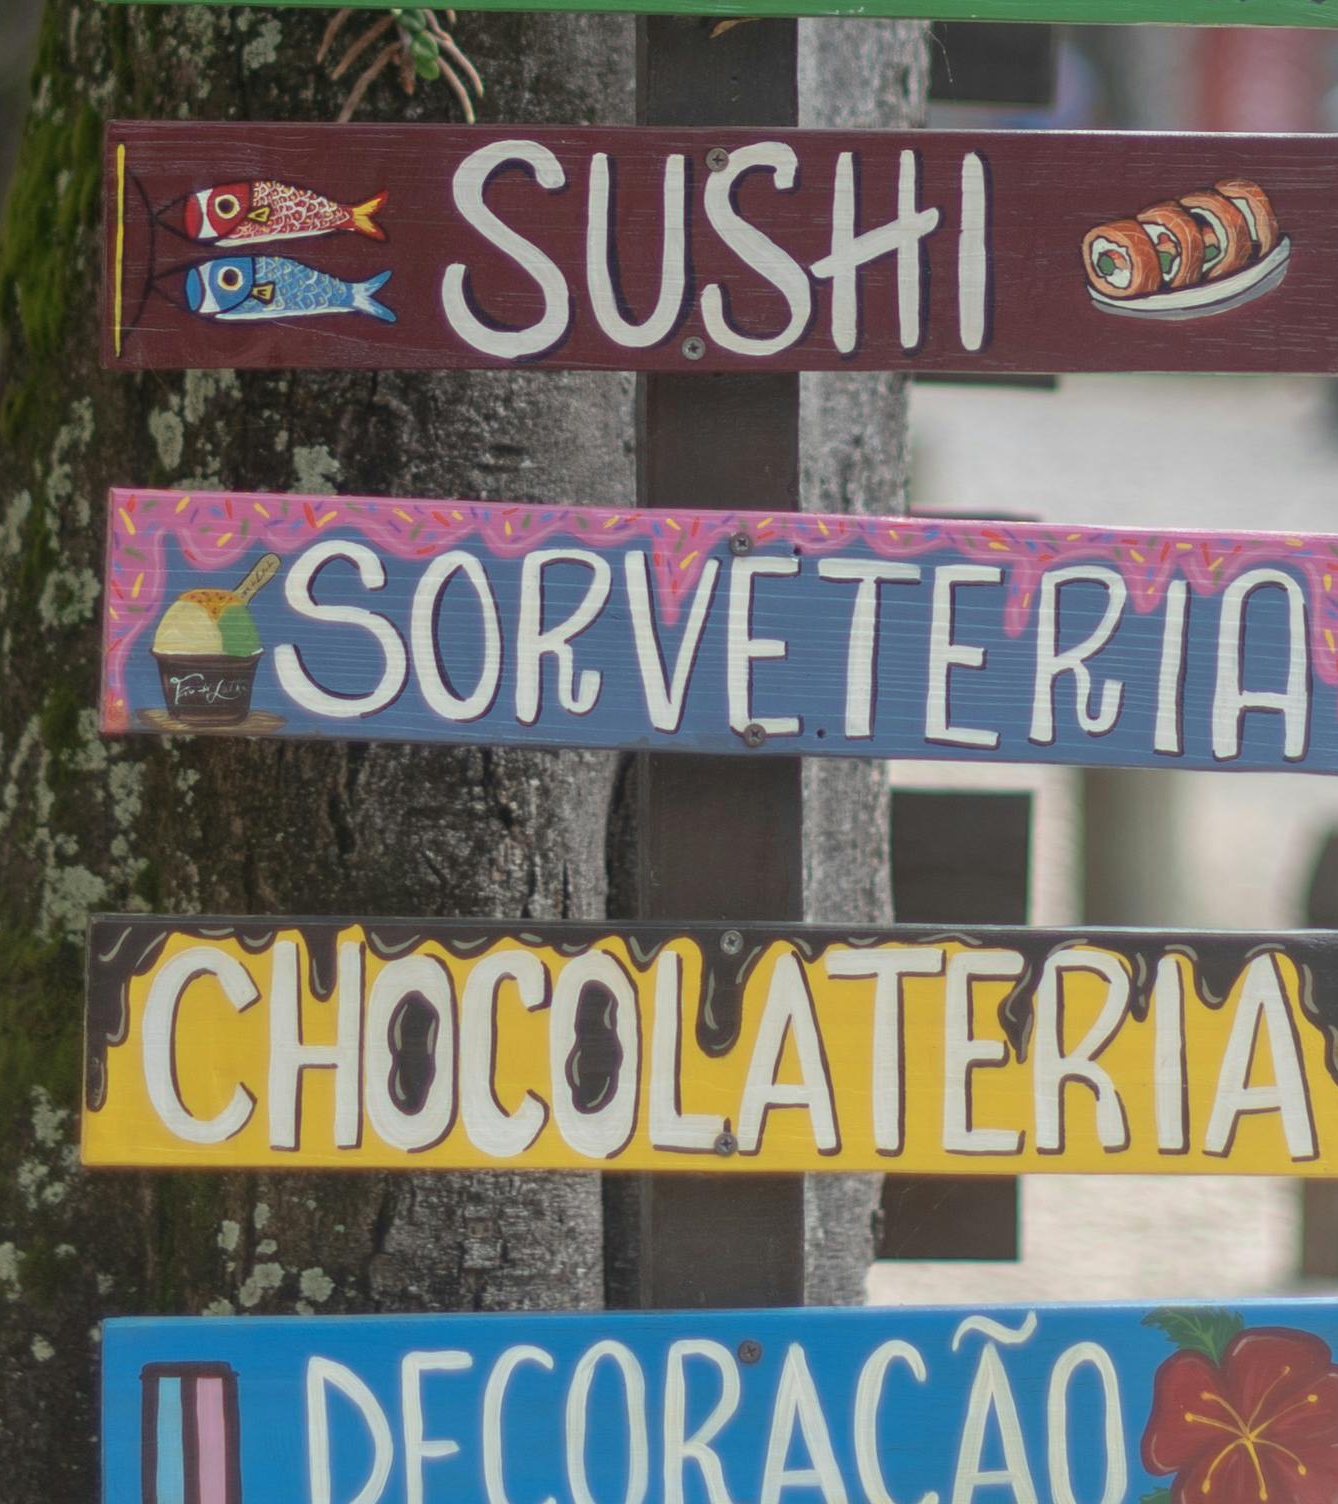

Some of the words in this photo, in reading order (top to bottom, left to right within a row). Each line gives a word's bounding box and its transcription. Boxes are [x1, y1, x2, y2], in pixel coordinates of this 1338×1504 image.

[441, 139, 996, 360] SUSHI
[273, 538, 1312, 762] SORVETERIA
[142, 937, 1320, 1162] CHOCOLATERIA
